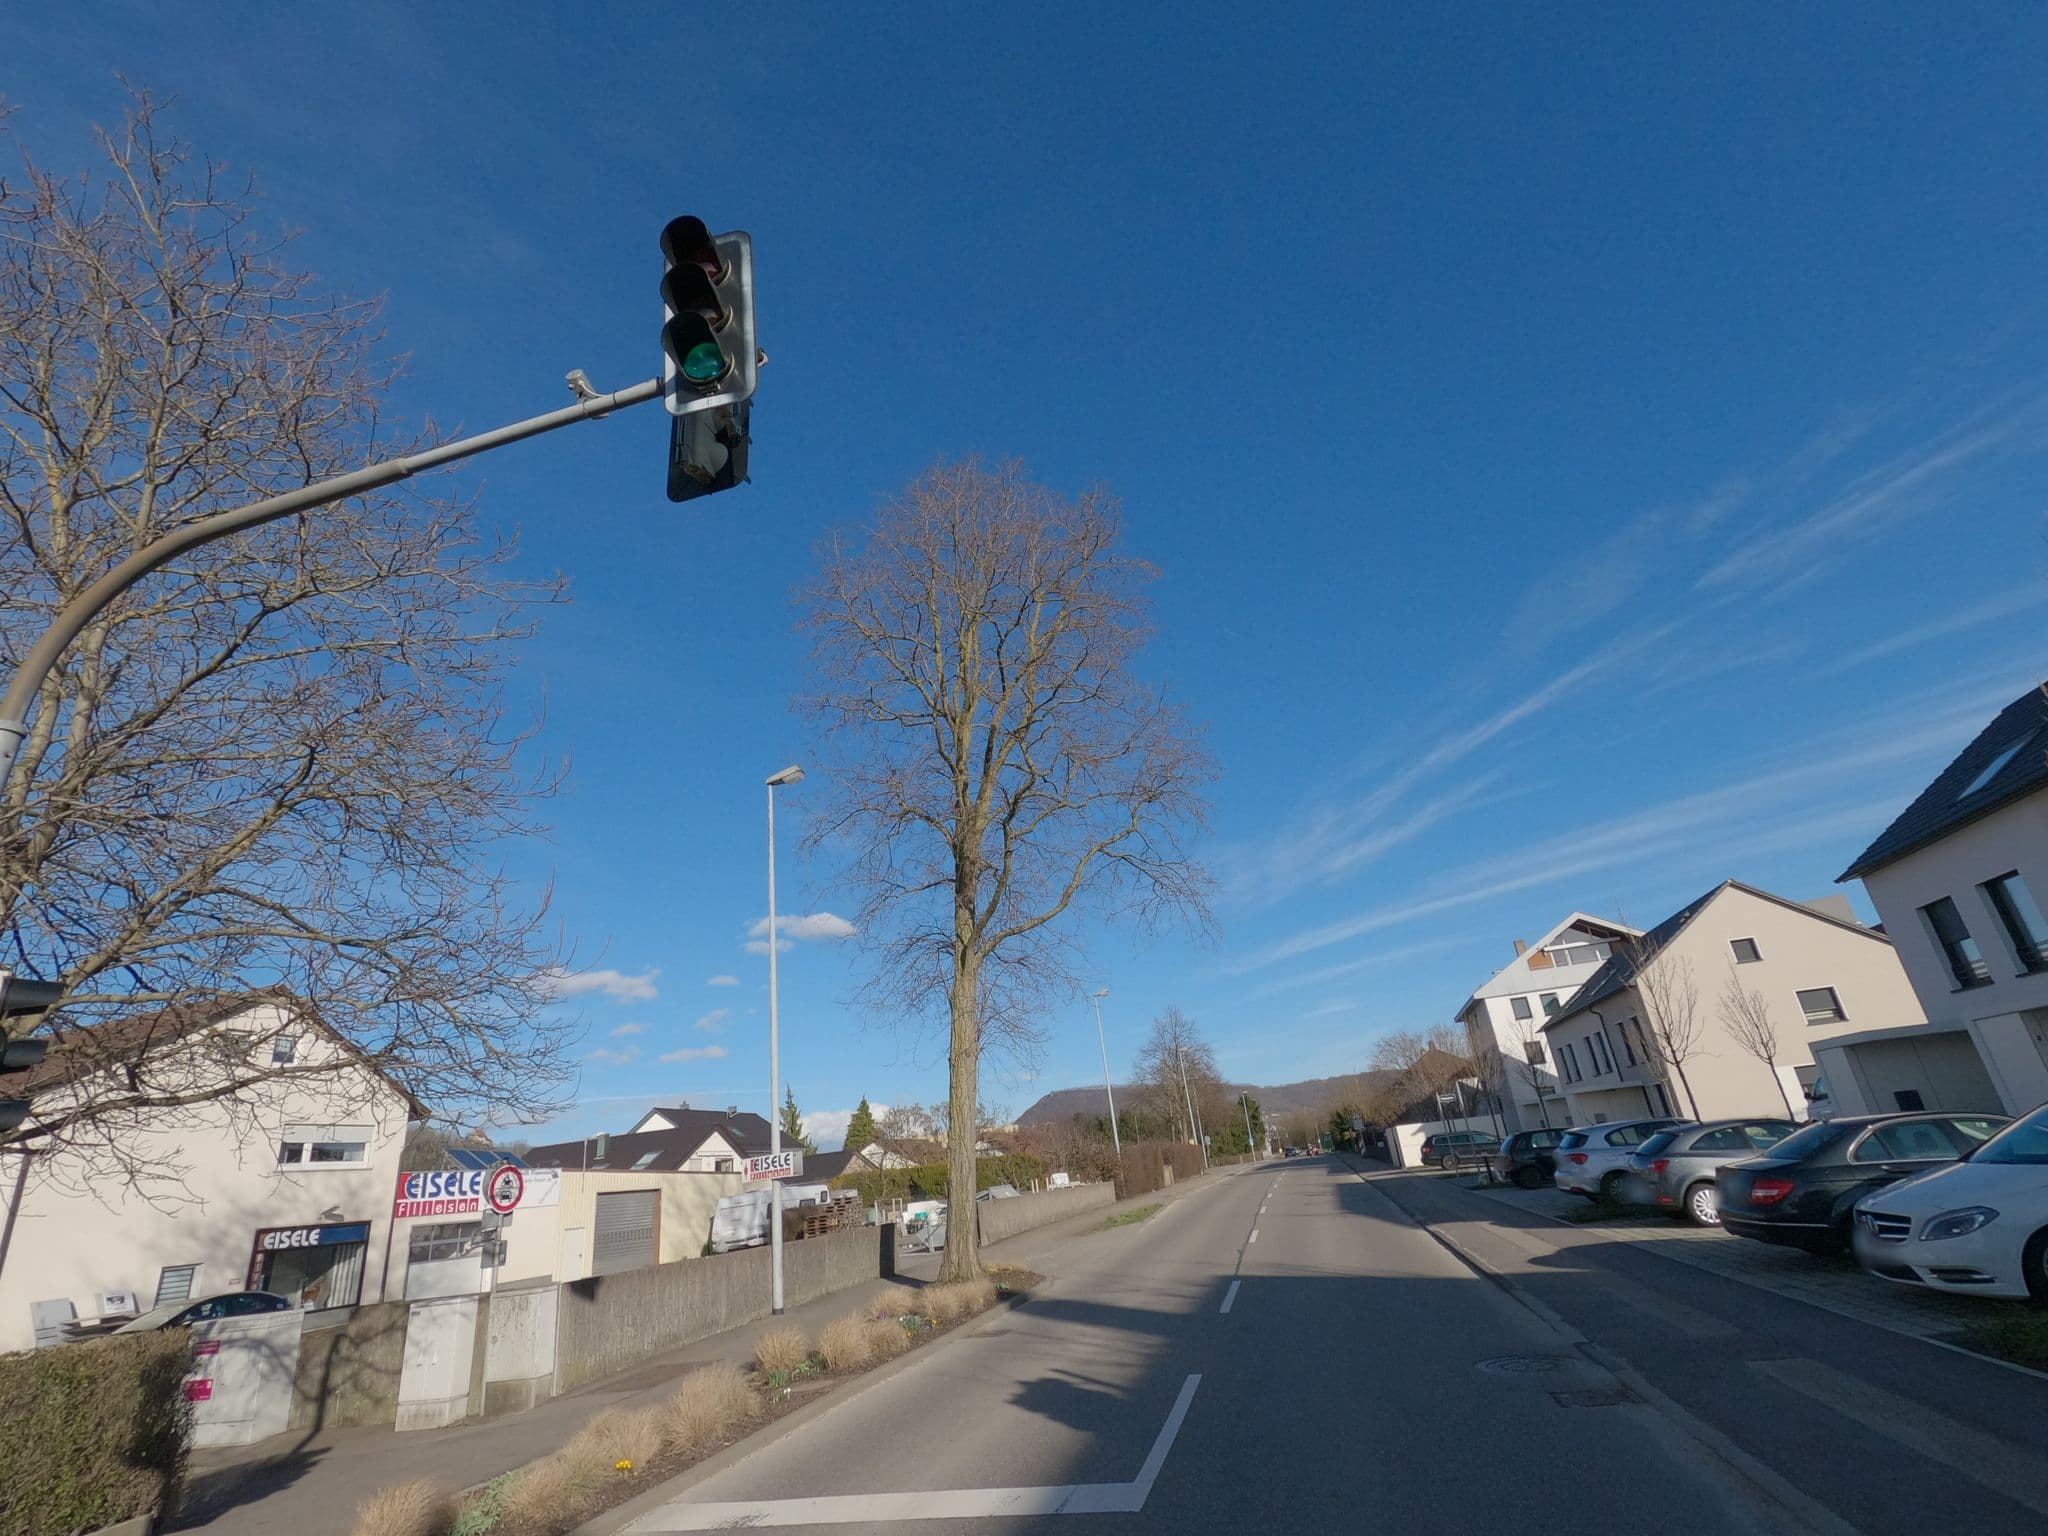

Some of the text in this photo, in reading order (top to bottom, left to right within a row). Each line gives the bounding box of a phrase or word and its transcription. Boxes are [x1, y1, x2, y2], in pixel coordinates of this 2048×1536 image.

[754, 1153, 790, 1171] EISELE
[406, 1171, 481, 1199] EISELE
[263, 1228, 320, 1250] EISELE
